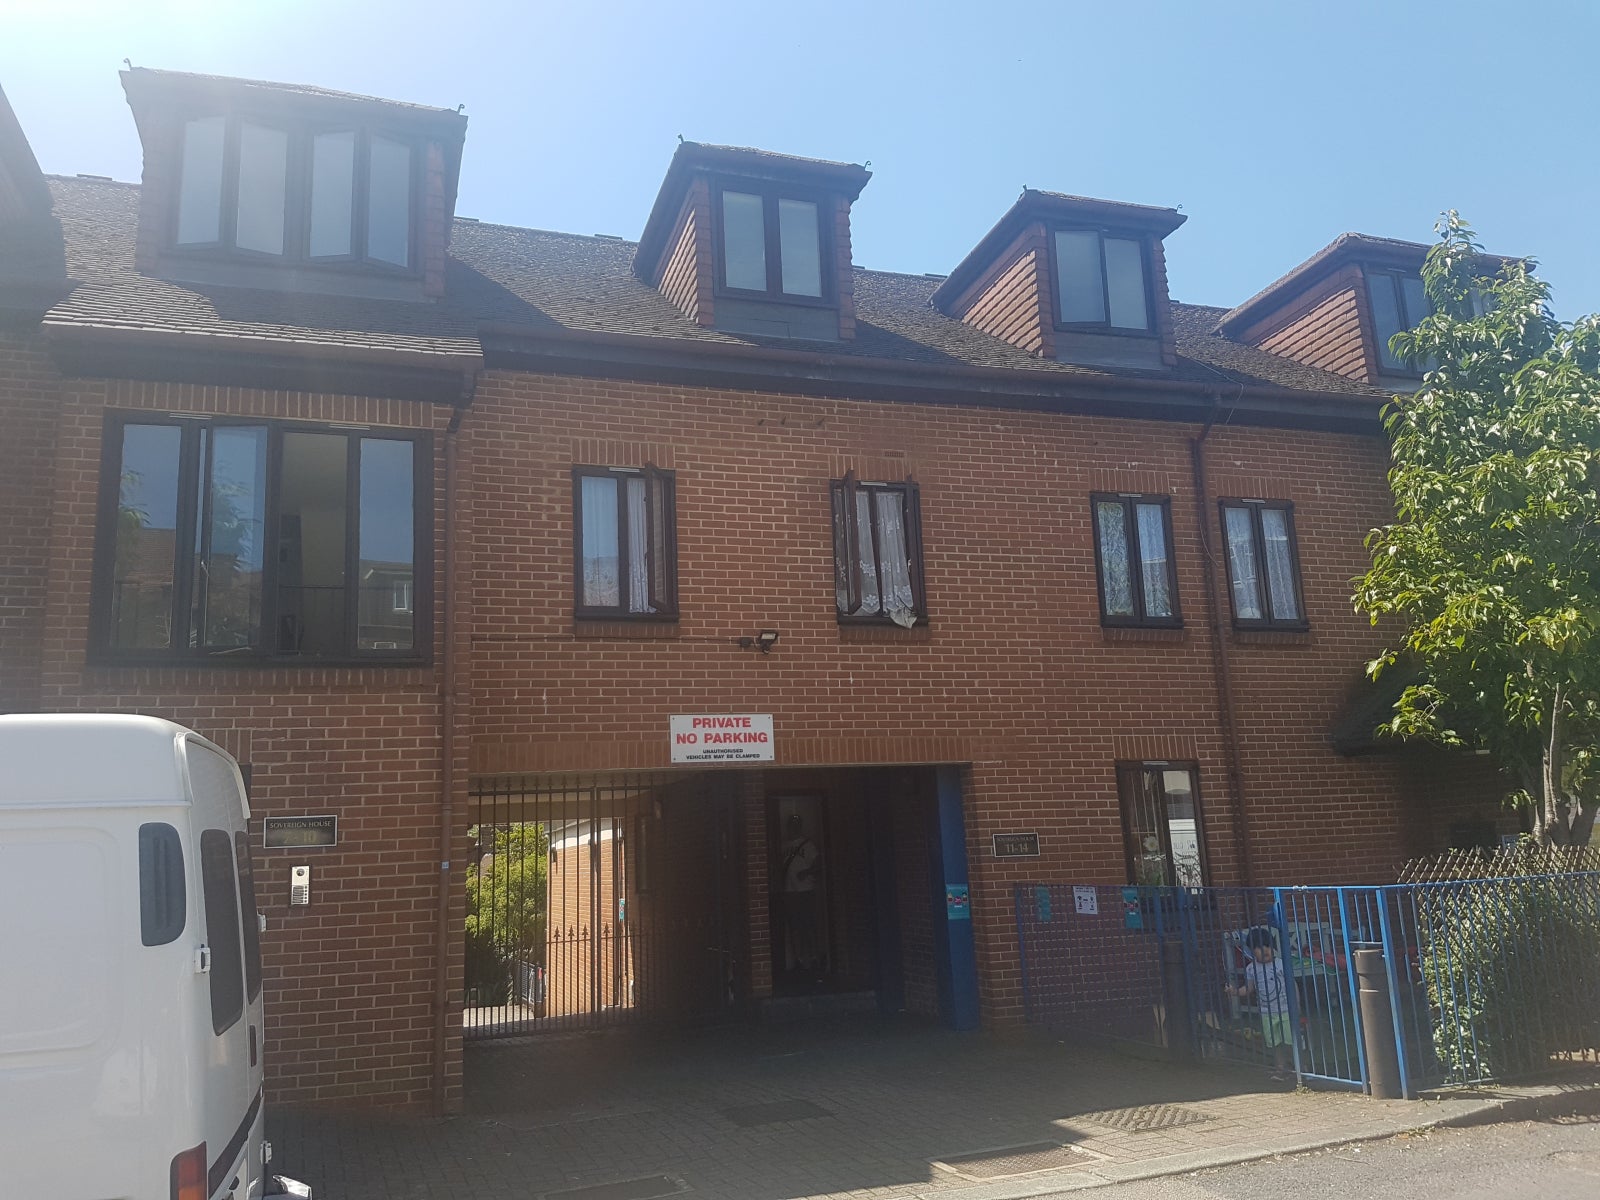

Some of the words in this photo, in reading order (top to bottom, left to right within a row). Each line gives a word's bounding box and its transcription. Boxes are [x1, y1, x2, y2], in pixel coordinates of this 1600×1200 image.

[693, 717, 752, 728] PRIVATE
[676, 733, 697, 744] NO
[704, 732, 768, 743] PARKING
